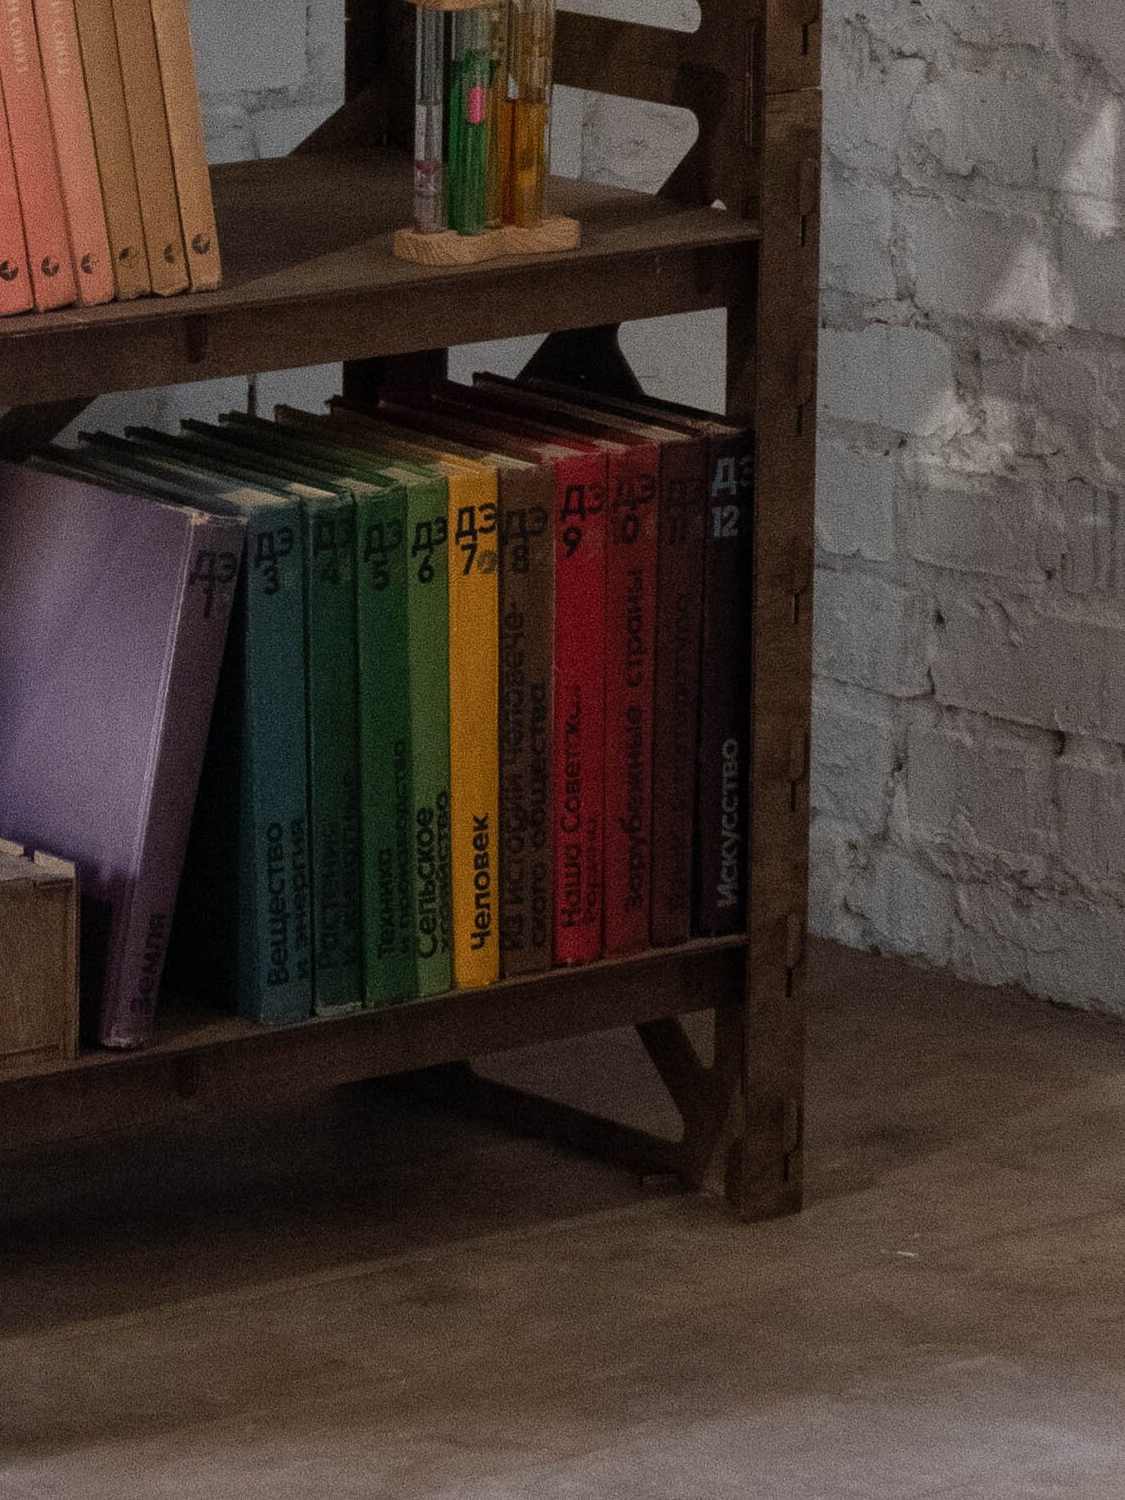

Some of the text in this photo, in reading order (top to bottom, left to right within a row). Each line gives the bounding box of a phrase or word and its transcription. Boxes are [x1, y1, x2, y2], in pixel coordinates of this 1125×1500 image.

[7, 16, 29, 75] СОЮЗ
[51, 18, 71, 75] СОЮЗ
[460, 542, 478, 577] 7
[510, 543, 531, 576] 8
[561, 524, 583, 559] 9
[711, 504, 740, 538] 12
[261, 562, 281, 597] 3
[371, 557, 392, 593] 5
[416, 553, 436, 585] 6
[618, 569, 647, 914] Зарубежные страны
[716, 739, 739, 908] Искусство
[265, 822, 291, 987] Вещество
[290, 819, 310, 980] и энергия
[376, 847, 396, 960] Техника
[415, 806, 438, 960] Сельское
[434, 790, 451, 956] хозяйство
[469, 813, 492, 953] Человек
[560, 842, 582, 928] Наша
[130, 913, 166, 1016] Земля
